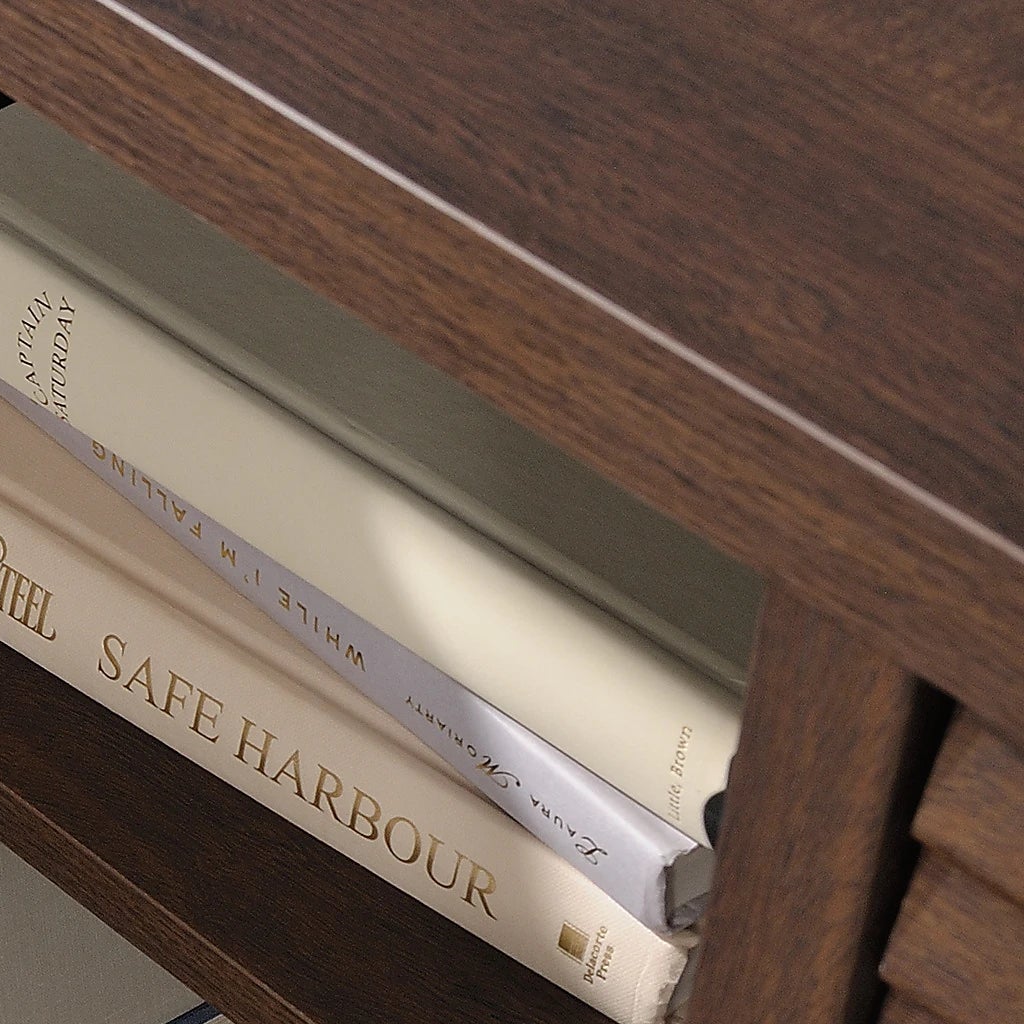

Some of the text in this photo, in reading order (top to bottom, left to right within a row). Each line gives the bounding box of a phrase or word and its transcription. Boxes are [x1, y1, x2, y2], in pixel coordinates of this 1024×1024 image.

[17, 291, 55, 406] CAPTAIN
[92, 439, 203, 539] FALLING
[278, 587, 367, 672] WHILE
[97, 633, 499, 921] SAFE HARBOUR
[405, 695, 608, 865] LAURA MORIARTY
[670, 725, 693, 777] Brown
[583, 926, 608, 984] Delacorte
[596, 945, 614, 981] Press
